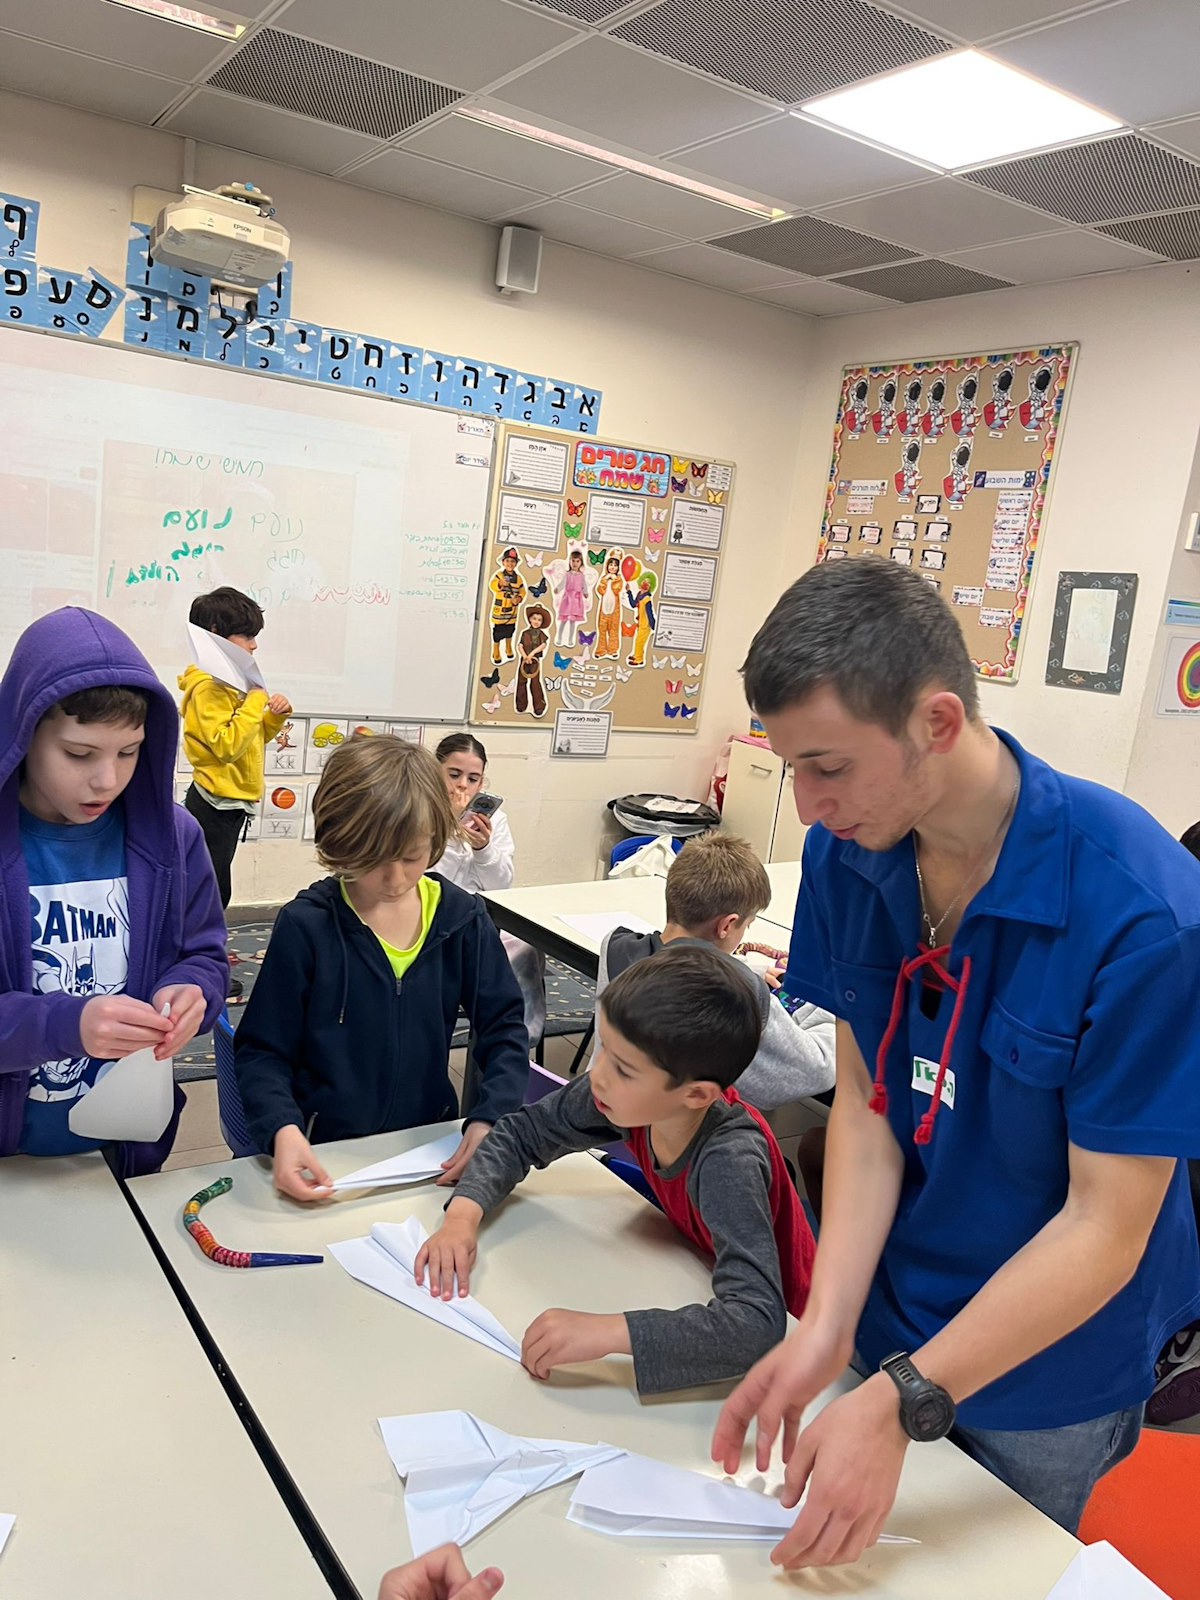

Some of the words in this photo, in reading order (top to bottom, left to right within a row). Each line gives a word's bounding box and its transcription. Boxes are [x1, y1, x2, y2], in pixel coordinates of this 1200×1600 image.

[233, 223, 252, 233] EPSON
[177, 305, 199, 333] מ
[331, 336, 349, 360] ט
[364, 344, 383, 369] ח
[402, 353, 413, 376] ז
[463, 366, 480, 390] ה
[495, 373, 509, 395] ד
[524, 382, 536, 404] ג
[551, 388, 566, 410] ב
[579, 393, 596, 417] א
[219, 456, 264, 478] חמישי
[581, 445, 637, 470] פורים
[640, 454, 666, 475] חג
[599, 468, 645, 491] שמח
[163, 506, 233, 531] נועם
[29, 892, 117, 945] BATMAN
